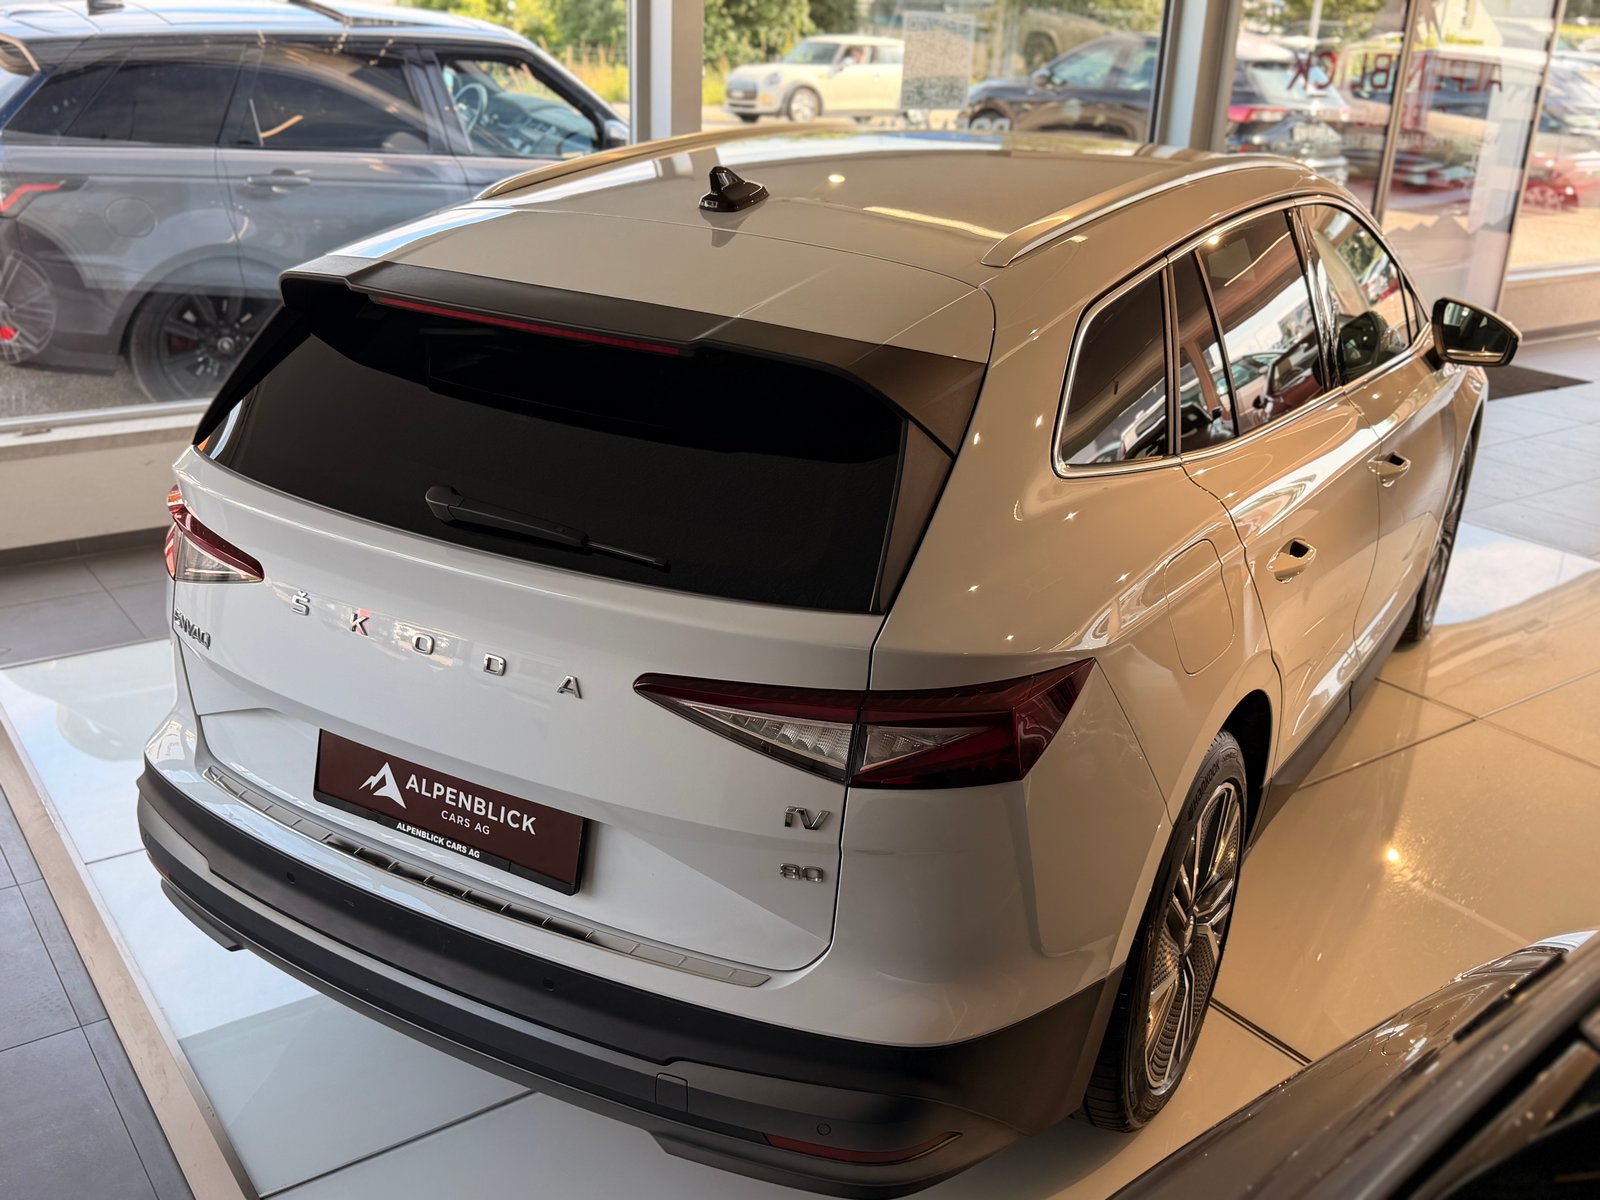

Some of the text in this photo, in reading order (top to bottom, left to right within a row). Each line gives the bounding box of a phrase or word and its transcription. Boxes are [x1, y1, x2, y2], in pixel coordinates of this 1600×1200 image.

[291, 590, 583, 700] ŠKODA
[405, 773, 537, 835] ALPENBLICK
[396, 822, 480, 859] ALPENBLICK CARS AG
[441, 810, 490, 836] CARS AG
[780, 862, 824, 883] 80
